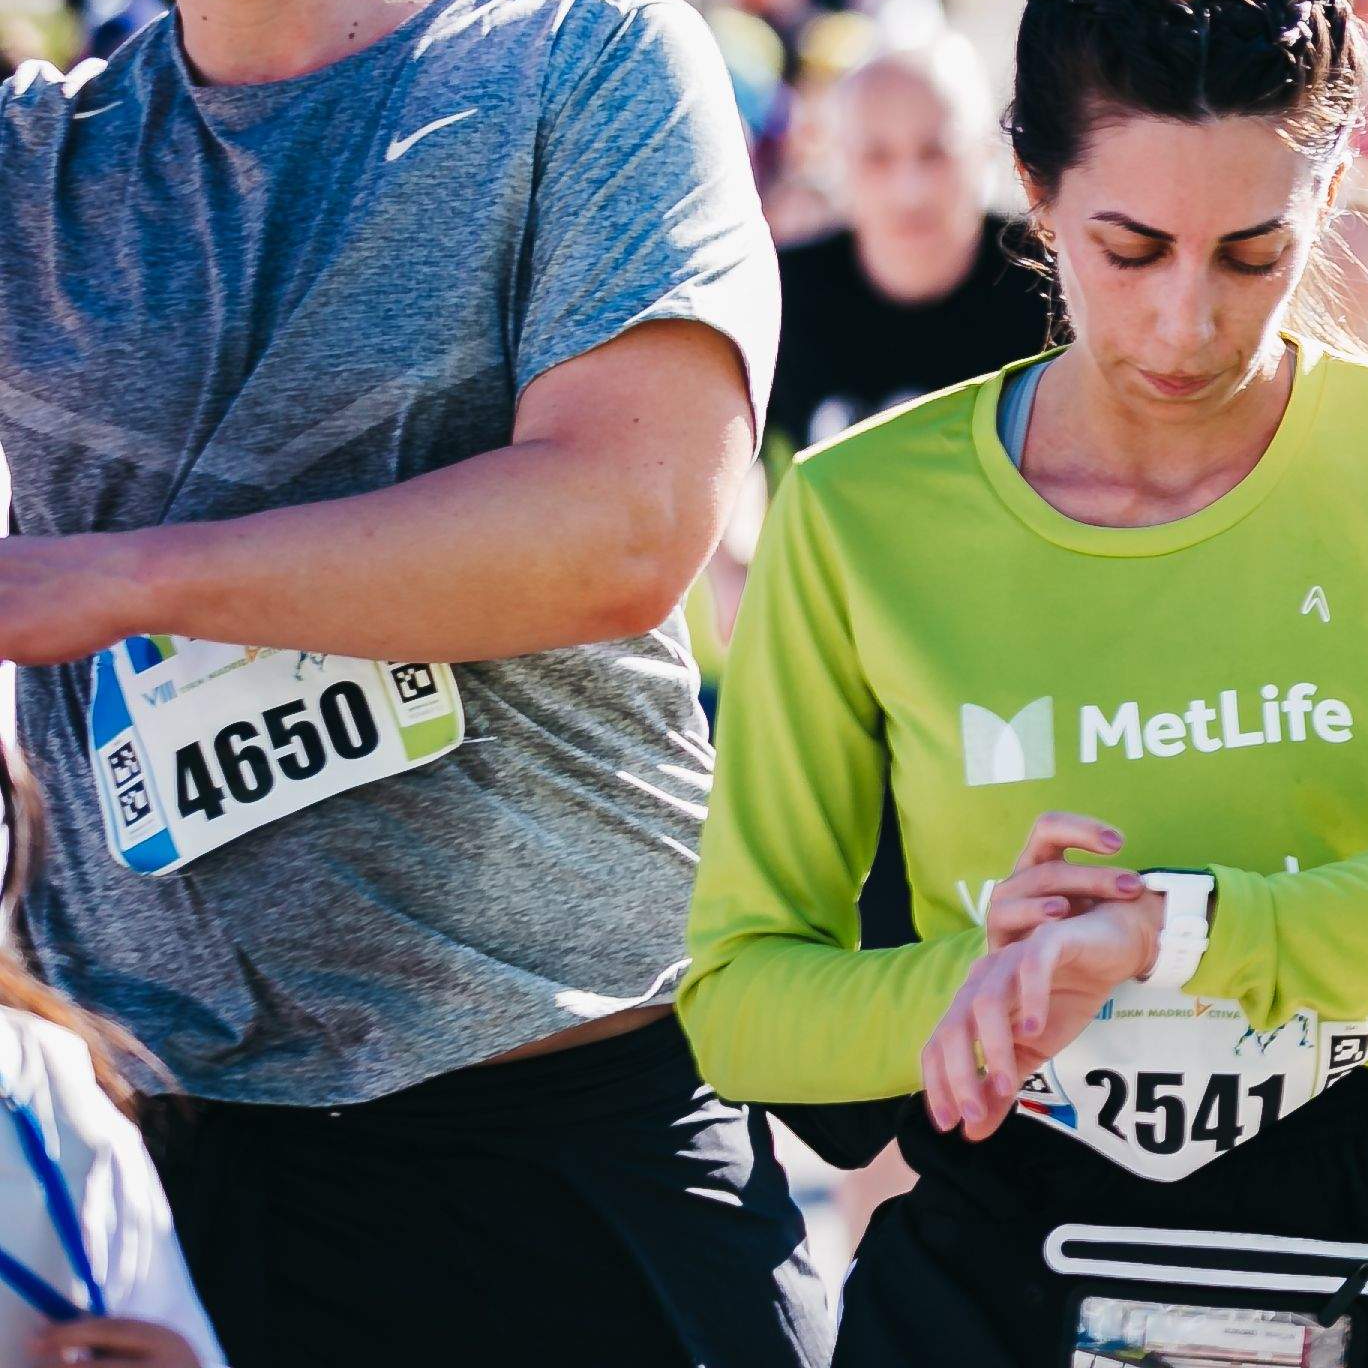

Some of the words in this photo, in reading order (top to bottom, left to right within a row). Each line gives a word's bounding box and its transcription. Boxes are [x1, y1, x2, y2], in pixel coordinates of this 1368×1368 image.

[174, 679, 380, 822] 4650
[1078, 682, 1354, 765] MetLife
[1084, 1066, 1288, 1157] 2541
